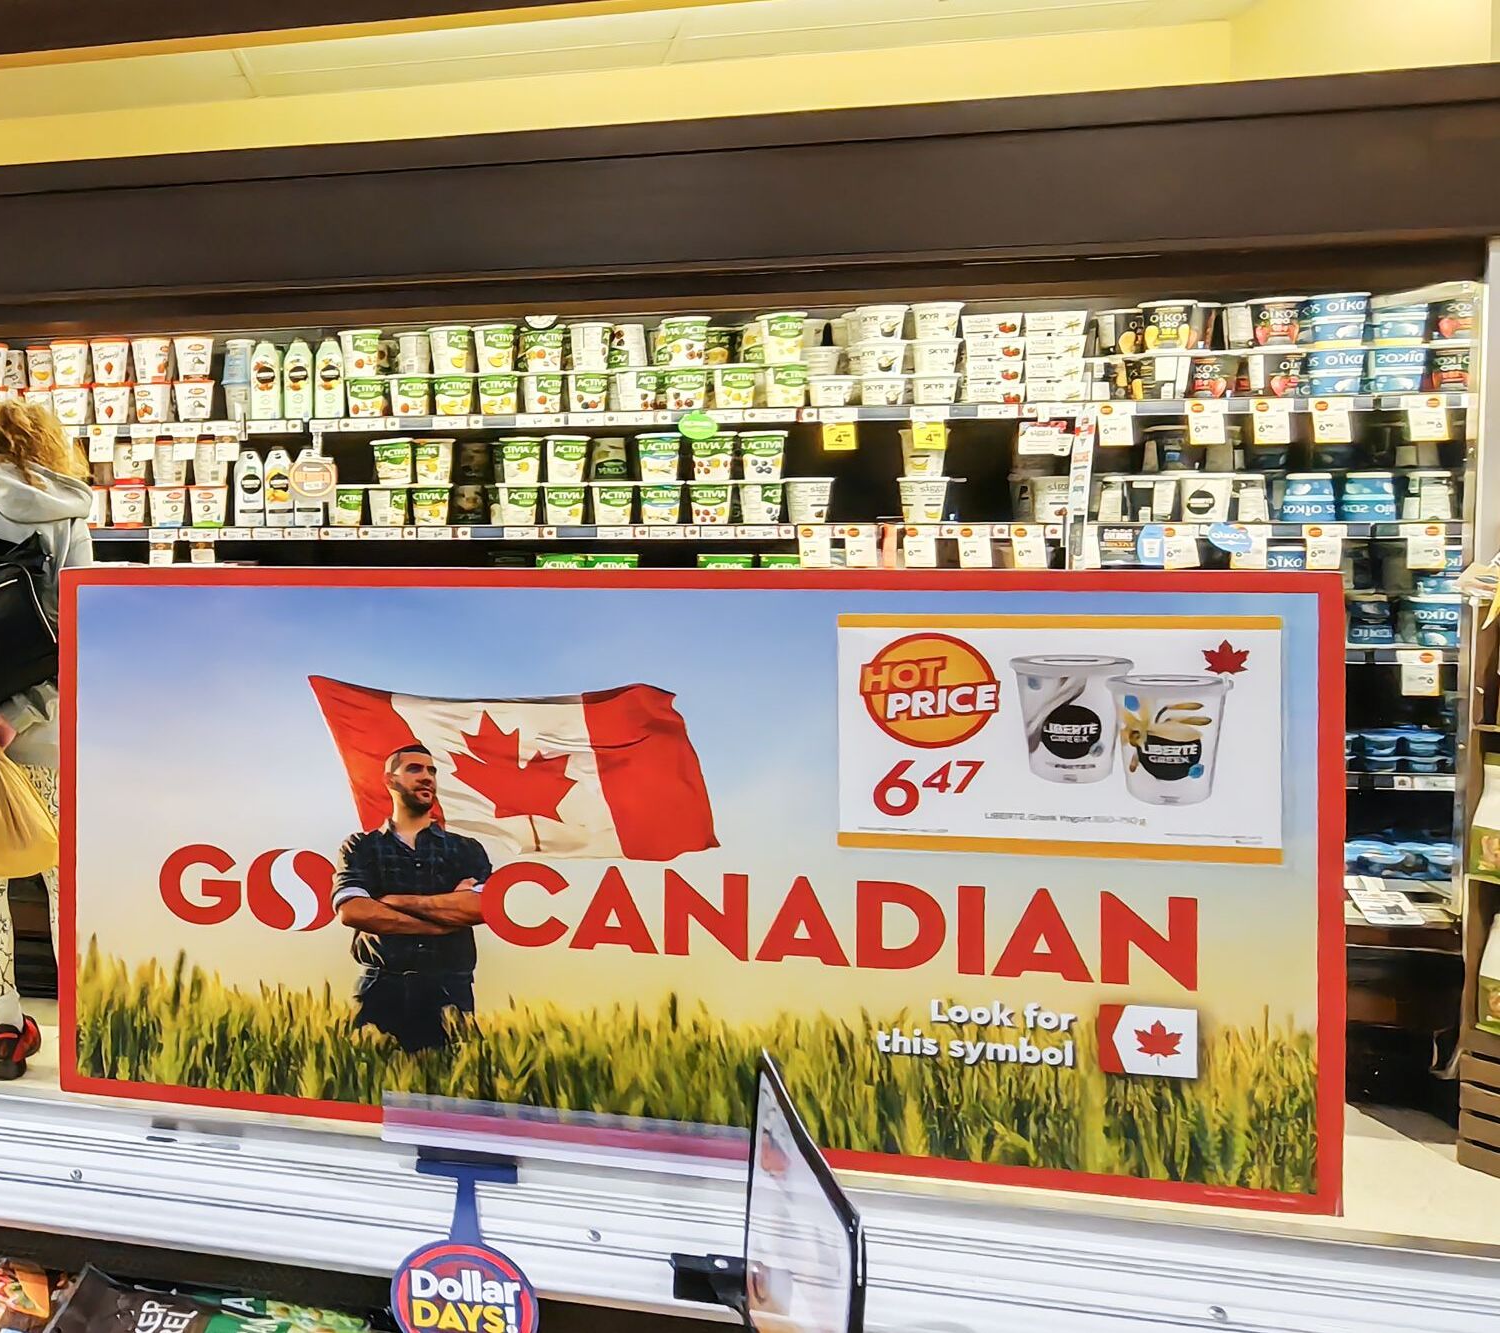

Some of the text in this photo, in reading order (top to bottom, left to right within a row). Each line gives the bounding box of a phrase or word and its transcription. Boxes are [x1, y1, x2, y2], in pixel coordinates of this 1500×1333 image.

[862, 658, 944, 693] HOT
[886, 684, 998, 720] PRICE
[480, 860, 1199, 992] CANADIAN
[930, 998, 1077, 1032] Look for
[877, 1028, 1074, 1068] this symbol
[409, 1267, 521, 1305] Dollar
[411, 1299, 519, 1333] DAYS!
